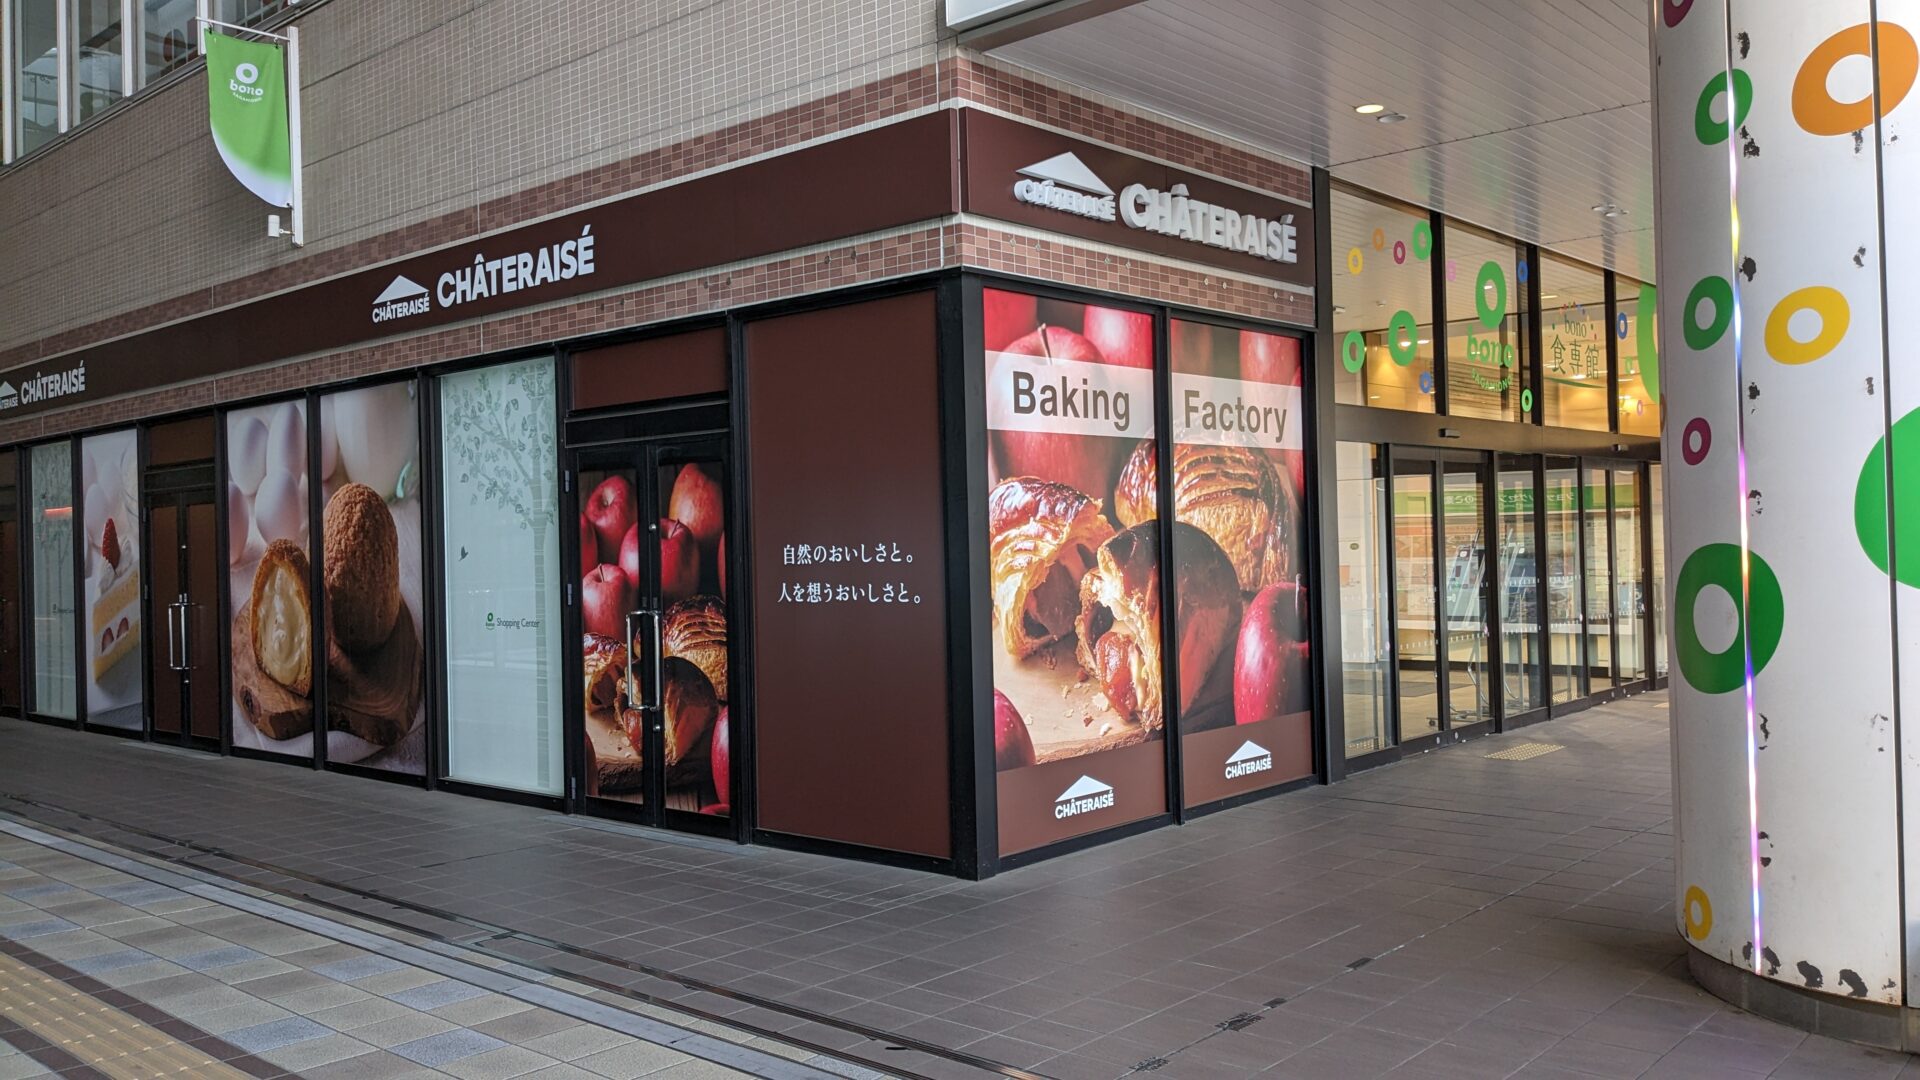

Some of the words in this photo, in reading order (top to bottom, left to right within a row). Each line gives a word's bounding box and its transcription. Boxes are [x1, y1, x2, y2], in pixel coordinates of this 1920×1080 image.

[229, 79, 264, 96] bono
[1013, 178, 1116, 222] CHÂTERAISÉ
[1119, 183, 1298, 264] CHÂTERAISÉ
[372, 291, 430, 323] CHÂTERAISÉ
[436, 224, 595, 308] CHÂTERAISÉ
[1564, 313, 1587, 338] bono
[1467, 323, 1515, 368] bono
[1550, 333, 1600, 380] 食専館
[21, 359, 86, 405] CHÂTERAISÉ
[1012, 370, 1131, 432] Baking
[1183, 389, 1288, 443] Factory
[783, 542, 914, 566] 自然のおいしさと。
[777, 582, 921, 604] 人を想うおいしさと。
[496, 617, 521, 630] Shopping
[521, 618, 540, 628] Center
[1225, 754, 1272, 780] CHÂTERAISÉ
[1055, 790, 1114, 820] CHÂTERAISÉ
